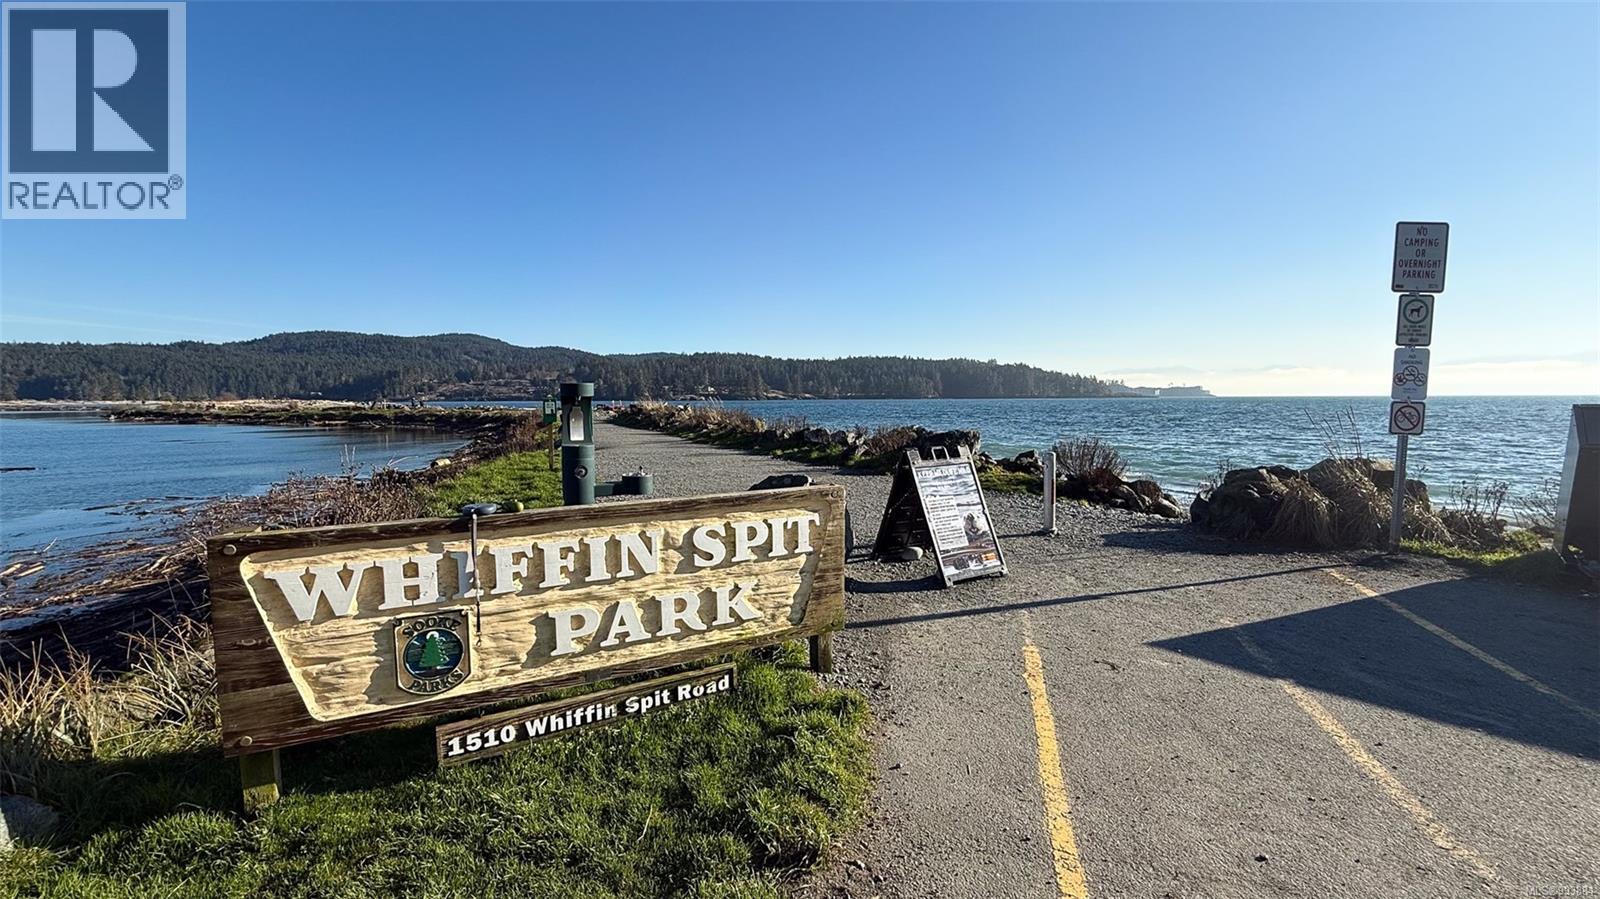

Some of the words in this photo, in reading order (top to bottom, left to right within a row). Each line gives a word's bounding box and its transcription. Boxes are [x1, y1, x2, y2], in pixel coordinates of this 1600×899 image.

[1416, 226, 1428, 237] NO
[1404, 238, 1440, 247] CAMPING
[1415, 249, 1426, 258] OR
[1398, 259, 1442, 269] OVERNIGHT
[1402, 270, 1436, 279] PARKING
[264, 527, 665, 622] WHIFFIN
[693, 513, 820, 567] SPIT
[549, 579, 764, 656] PARK
[403, 615, 462, 638] SOOKE
[411, 668, 465, 692] PARKS
[448, 725, 517, 757] 1510
[525, 703, 618, 738] Whiffin
[625, 691, 671, 714] Spit
[677, 674, 731, 702] Road
